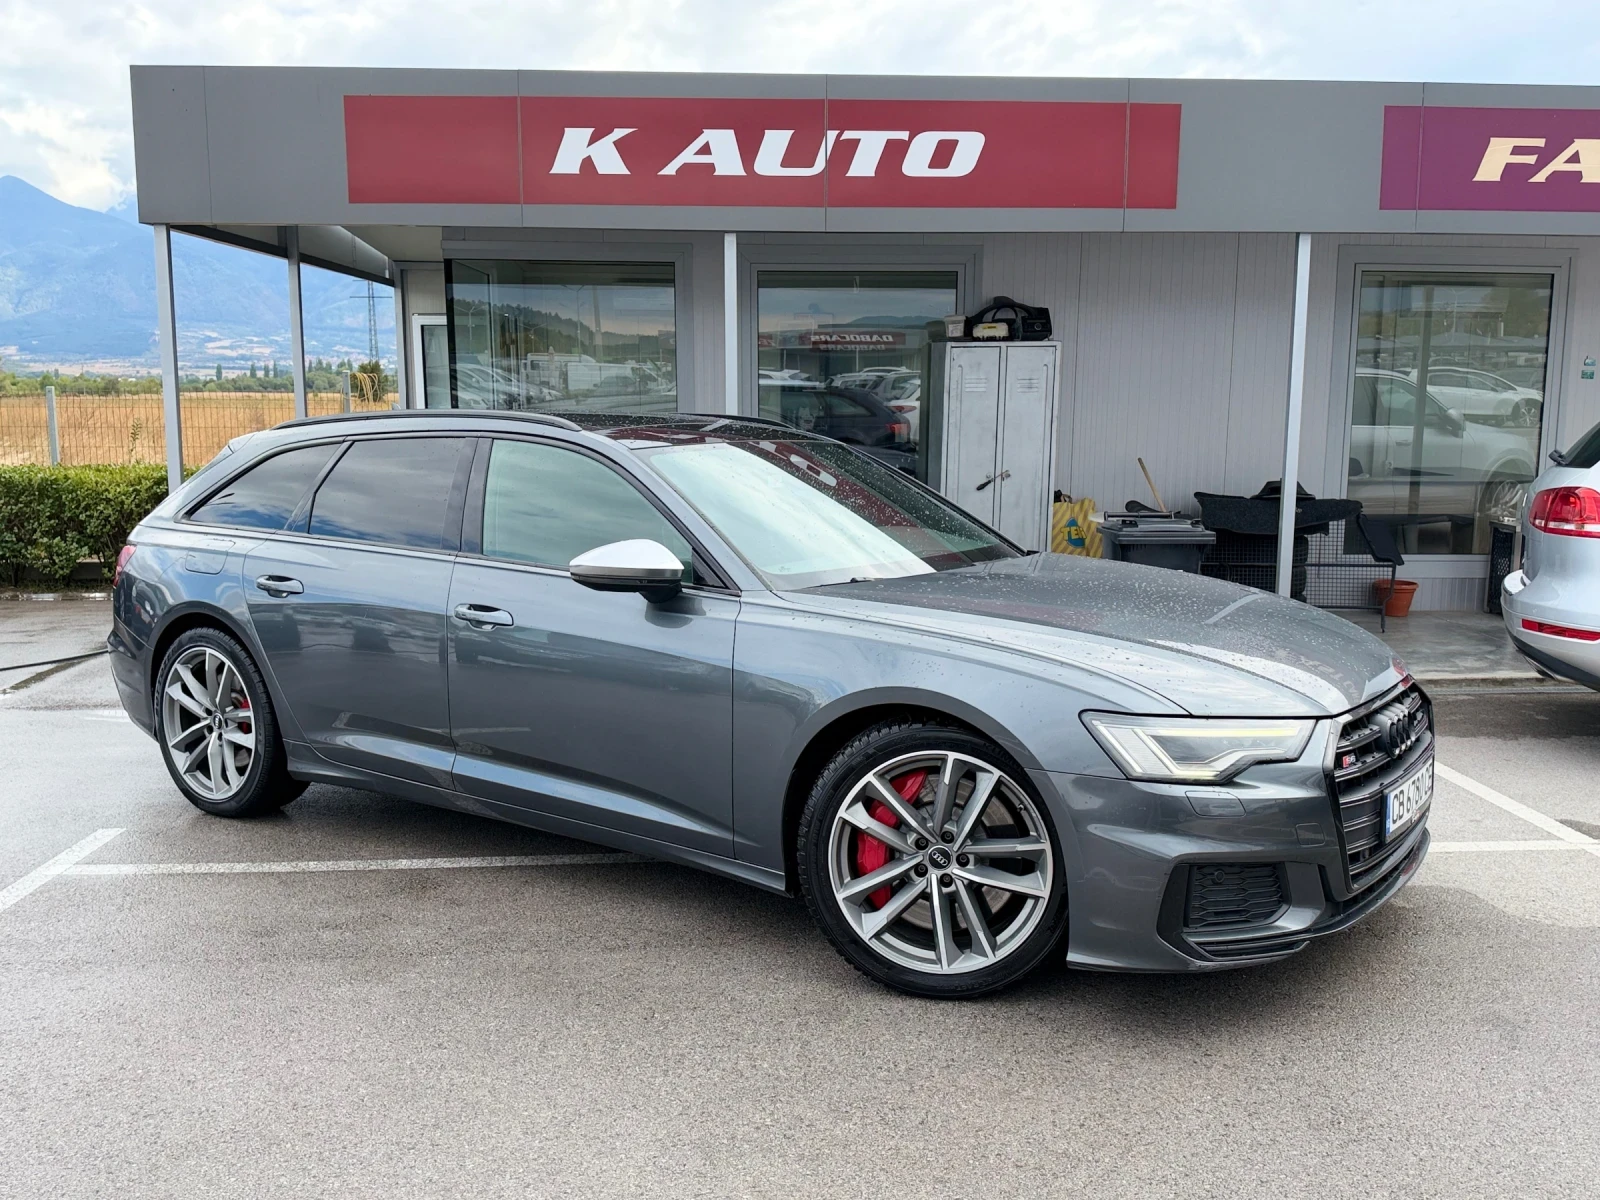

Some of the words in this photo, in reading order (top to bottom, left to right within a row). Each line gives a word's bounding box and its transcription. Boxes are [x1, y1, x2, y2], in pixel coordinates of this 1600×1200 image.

[549, 128, 637, 174] K
[658, 129, 985, 177] AUTO
[1472, 137, 1600, 183] FA
[1392, 789, 1405, 824] CB
[1406, 772, 1424, 814] 6780
